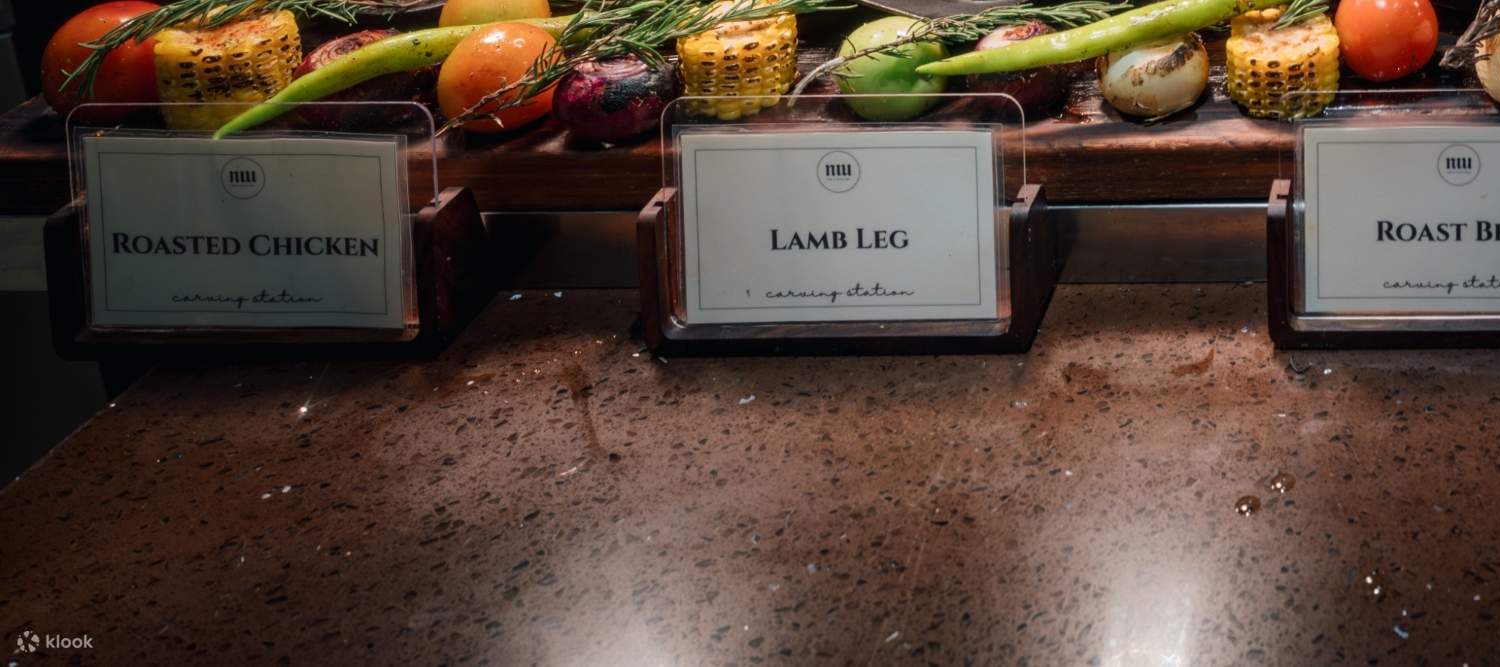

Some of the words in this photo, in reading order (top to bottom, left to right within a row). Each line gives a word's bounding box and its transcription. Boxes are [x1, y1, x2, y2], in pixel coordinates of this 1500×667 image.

[770, 229, 848, 250] LAMB
[856, 228, 909, 249] LEG
[1376, 220, 1468, 242] ROAST
[111, 232, 241, 256] ROASTED
[248, 234, 380, 257] CHICKEN
[765, 287, 843, 303] carving
[846, 282, 915, 297] station
[1383, 280, 1459, 294] carving
[171, 292, 249, 309] carving
[251, 289, 323, 304] station
